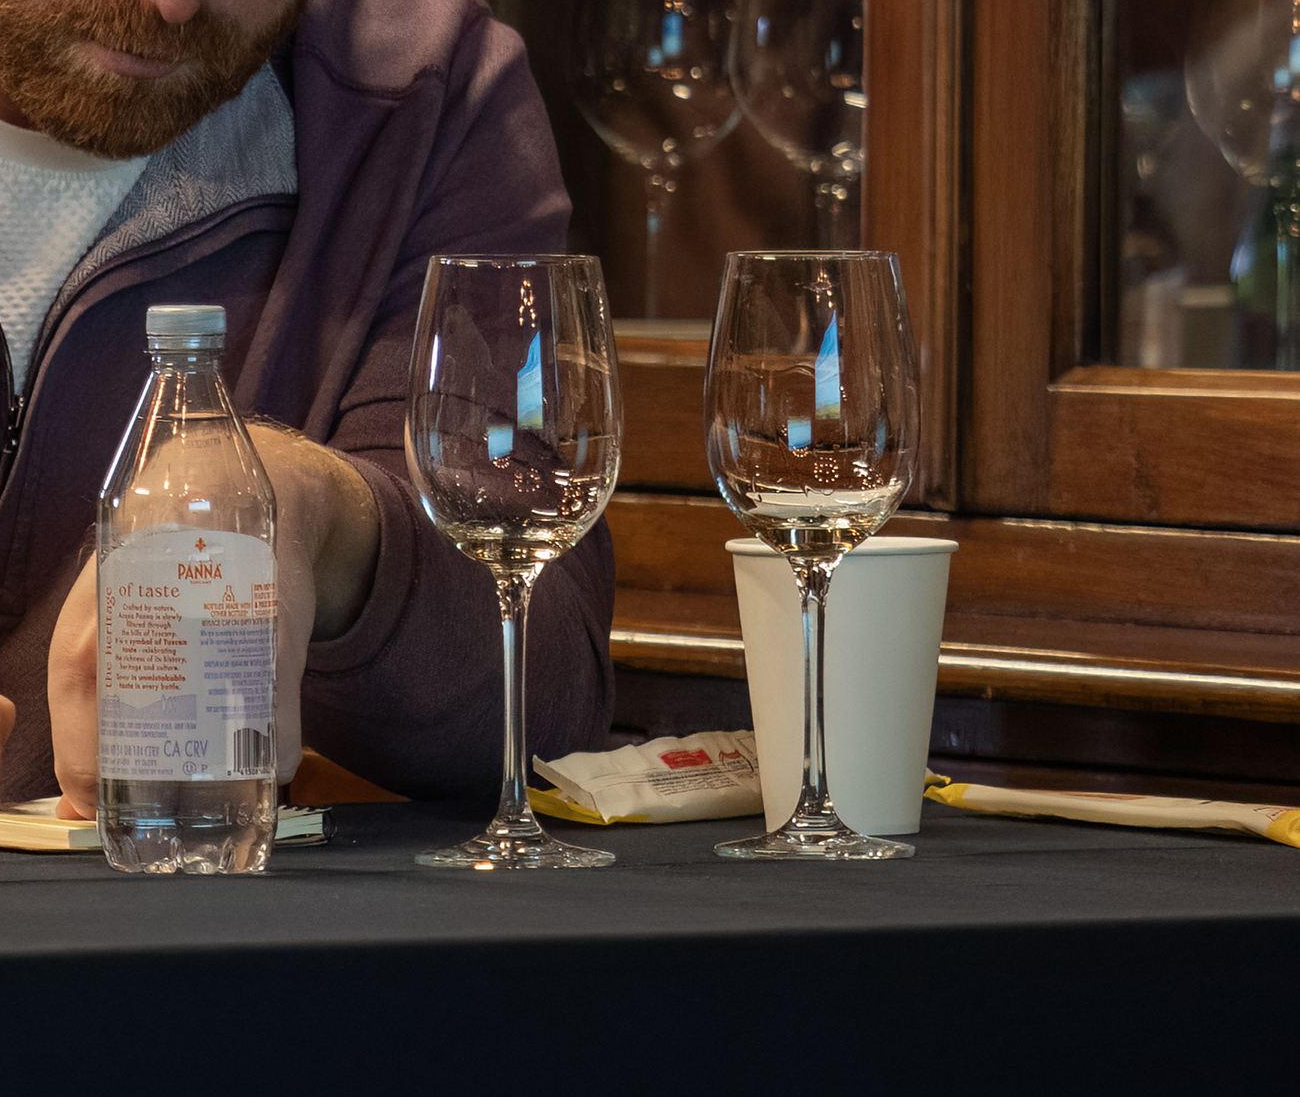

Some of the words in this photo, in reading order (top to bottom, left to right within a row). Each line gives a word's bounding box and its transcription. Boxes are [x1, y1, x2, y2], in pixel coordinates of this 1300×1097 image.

[177, 562, 222, 579] PANNA
[119, 582, 134, 598] of
[138, 584, 181, 599] taste
[163, 740, 181, 757] CA
[185, 740, 209, 757] CRV
